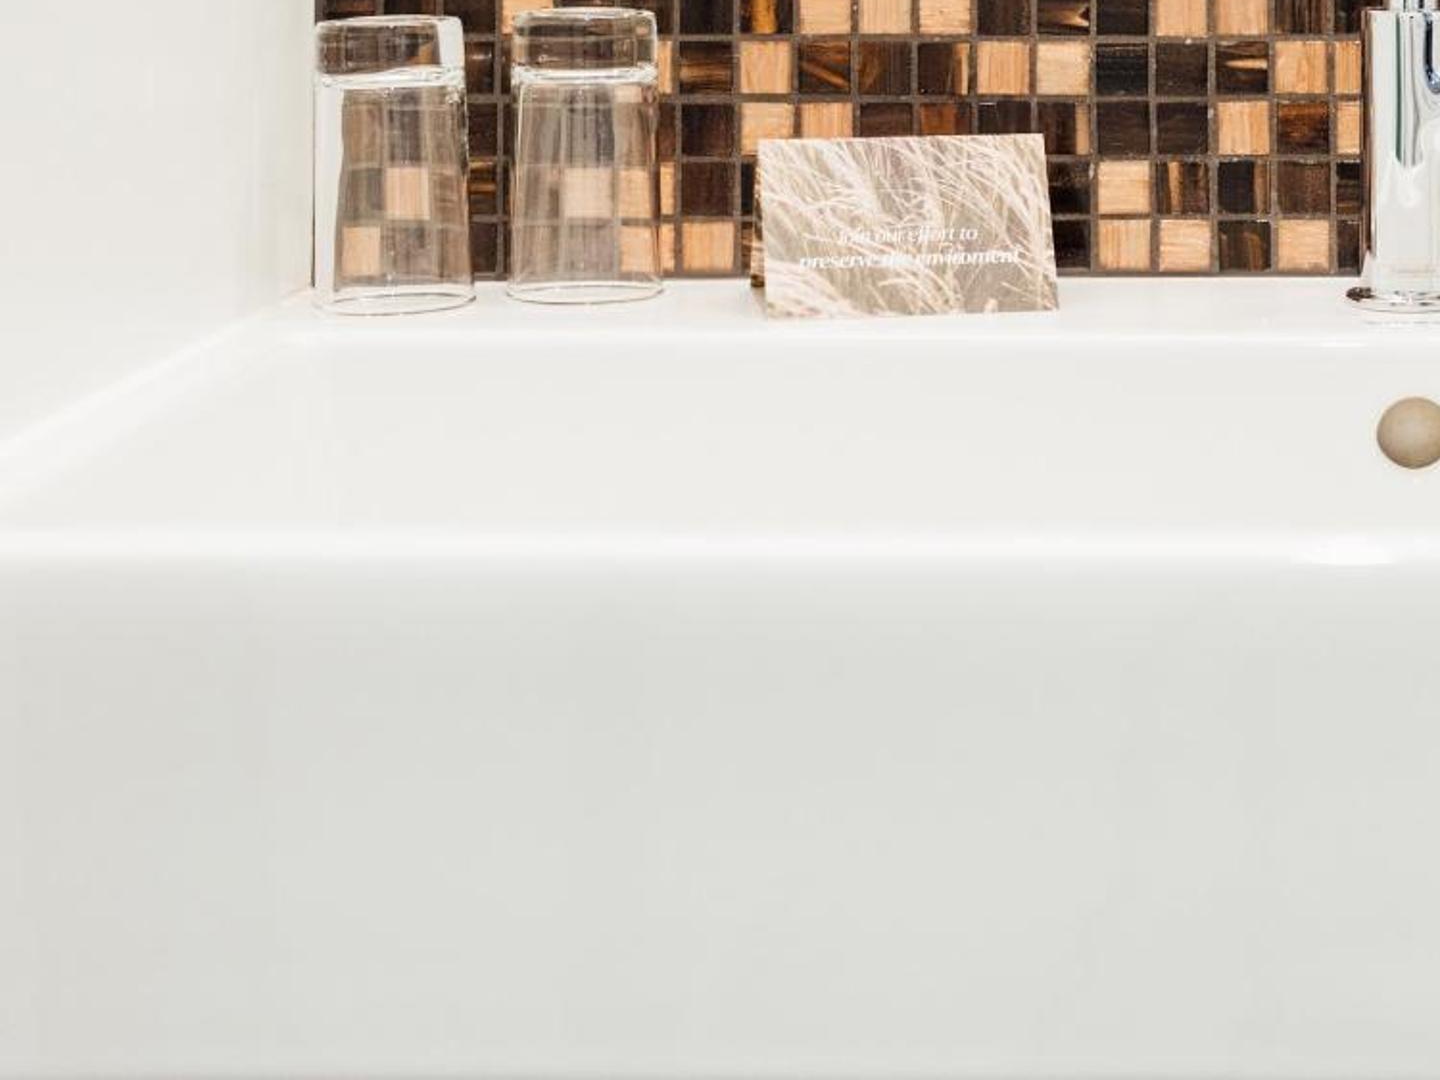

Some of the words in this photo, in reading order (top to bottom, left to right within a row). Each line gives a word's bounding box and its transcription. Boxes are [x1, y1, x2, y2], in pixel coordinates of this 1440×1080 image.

[905, 224, 955, 246] effort
[960, 226, 979, 241] to
[799, 254, 881, 273] preserve
